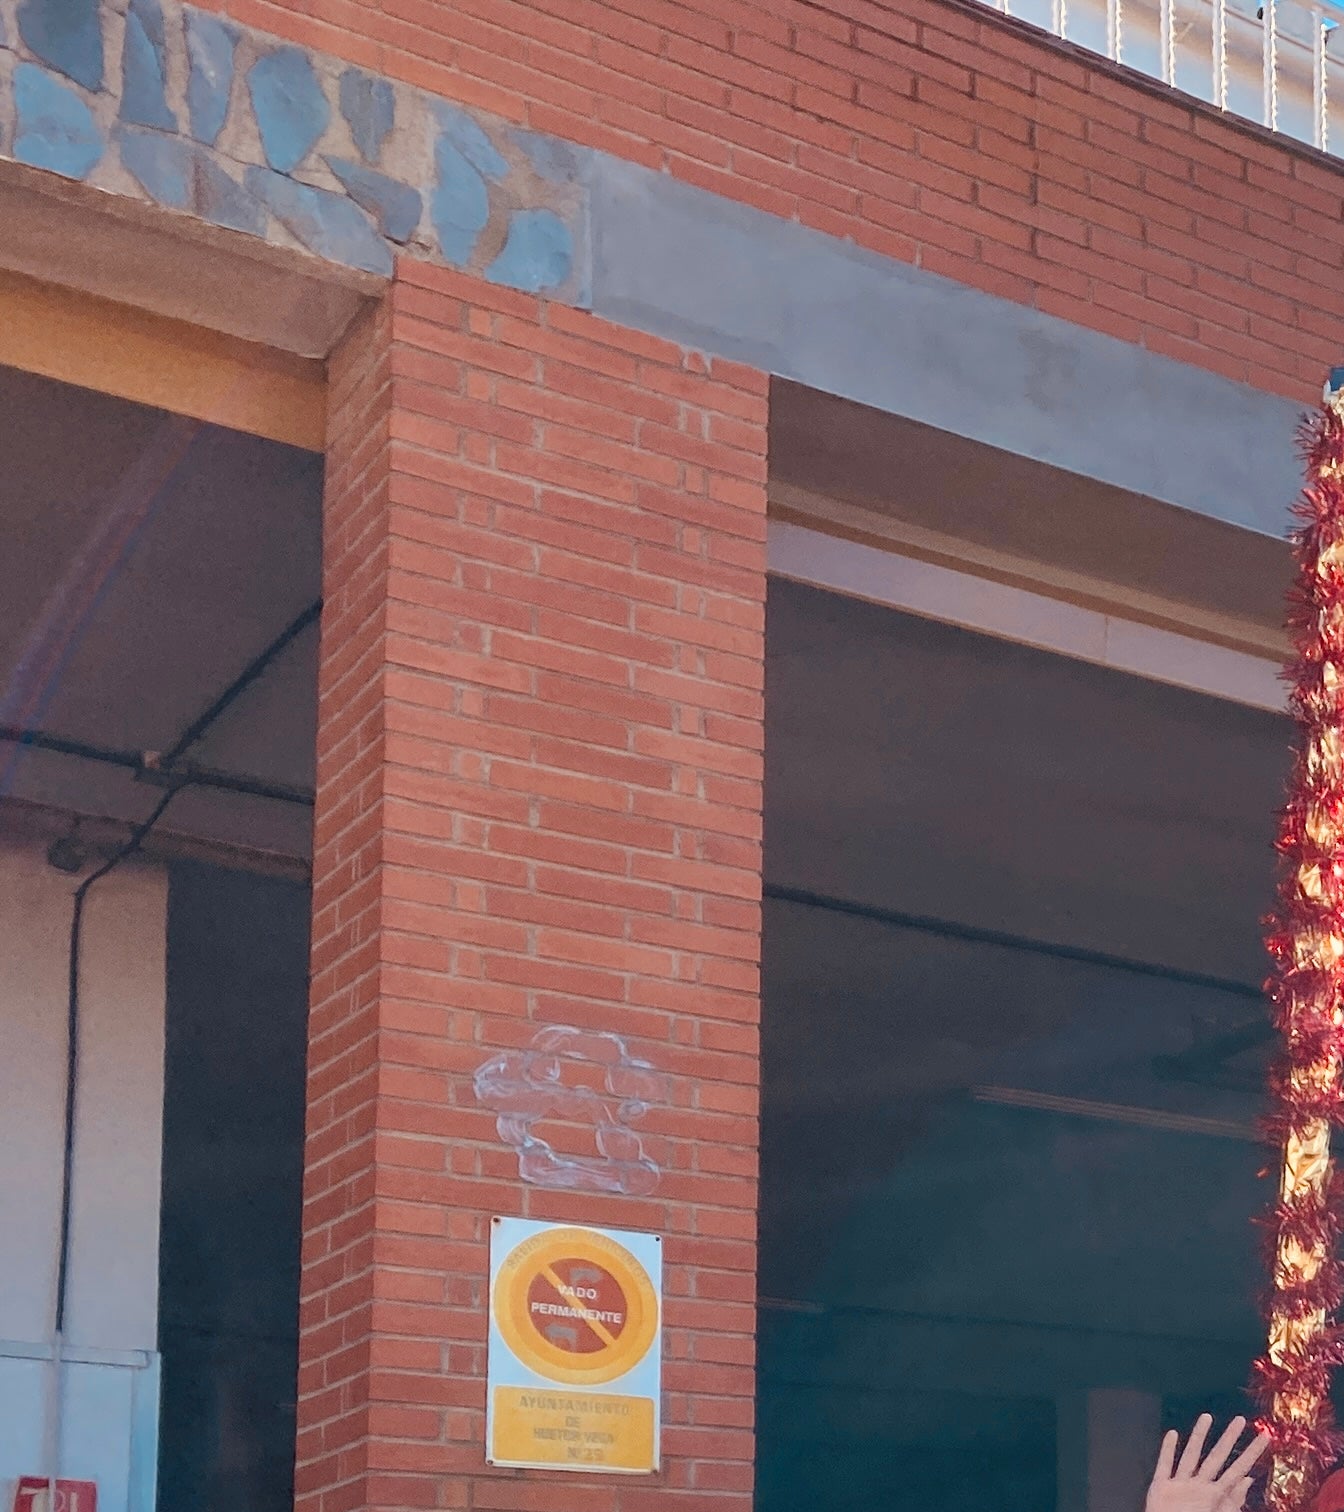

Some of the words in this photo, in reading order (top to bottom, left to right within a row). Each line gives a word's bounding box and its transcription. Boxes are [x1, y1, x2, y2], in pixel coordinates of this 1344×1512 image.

[557, 1284, 597, 1299] VADO
[531, 1302, 623, 1324] PERMANENTE
[519, 1395, 630, 1416] AYUNTAMIENTO
